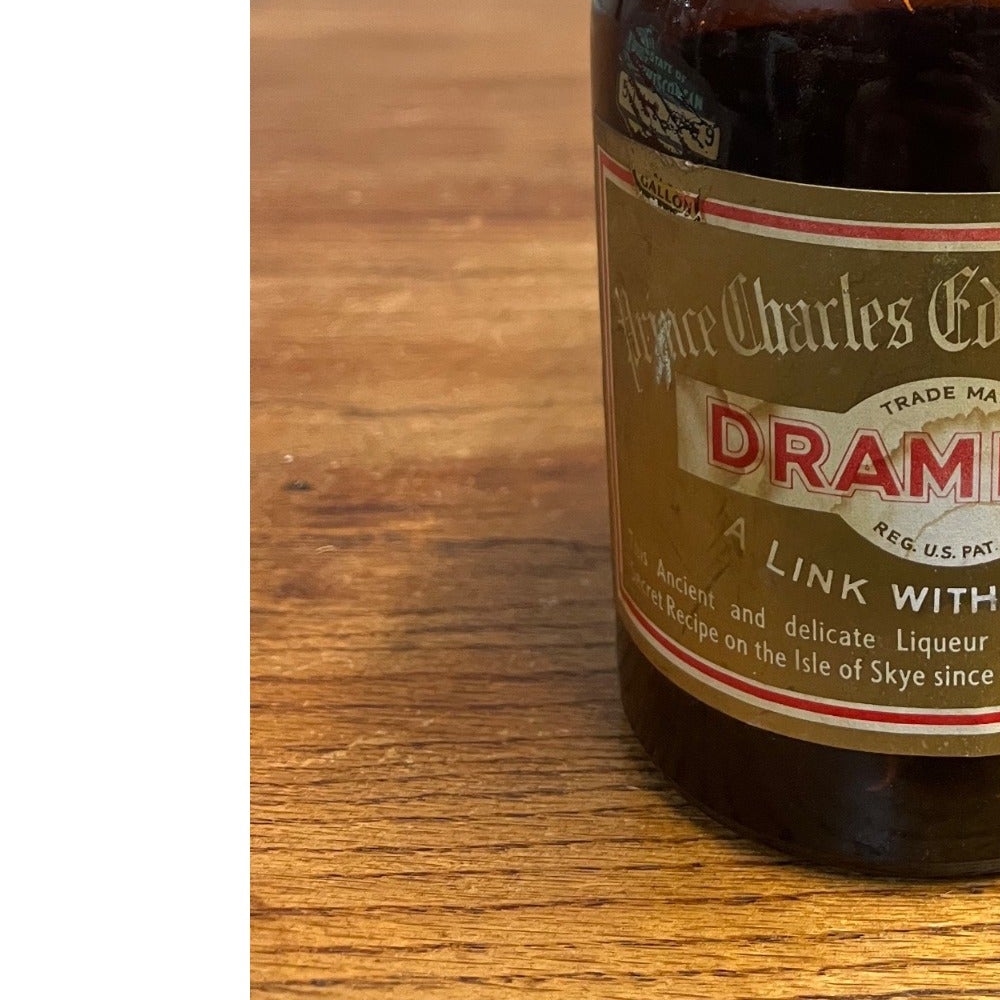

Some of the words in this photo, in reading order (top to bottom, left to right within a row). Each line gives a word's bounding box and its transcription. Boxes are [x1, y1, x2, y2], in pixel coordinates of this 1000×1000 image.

[722, 272, 913, 357] Charles
[880, 386, 956, 416] TRADE
[724, 517, 746, 551] A
[766, 539, 869, 605] LINK
[891, 583, 998, 614] WITH
[873, 521, 917, 552] REG.
[924, 543, 956, 559] U.S.
[962, 541, 998, 558] PAT.
[656, 558, 716, 610] Ancient
[730, 604, 765, 629] and
[785, 615, 876, 649] delicate
[897, 628, 989, 659] Liqueur
[666, 594, 718, 643] Recipe
[724, 634, 748, 655] on
[754, 641, 787, 668] the
[795, 649, 831, 676] Isle
[839, 658, 862, 680] of
[871, 660, 925, 692] Skye
[934, 665, 994, 686] since
